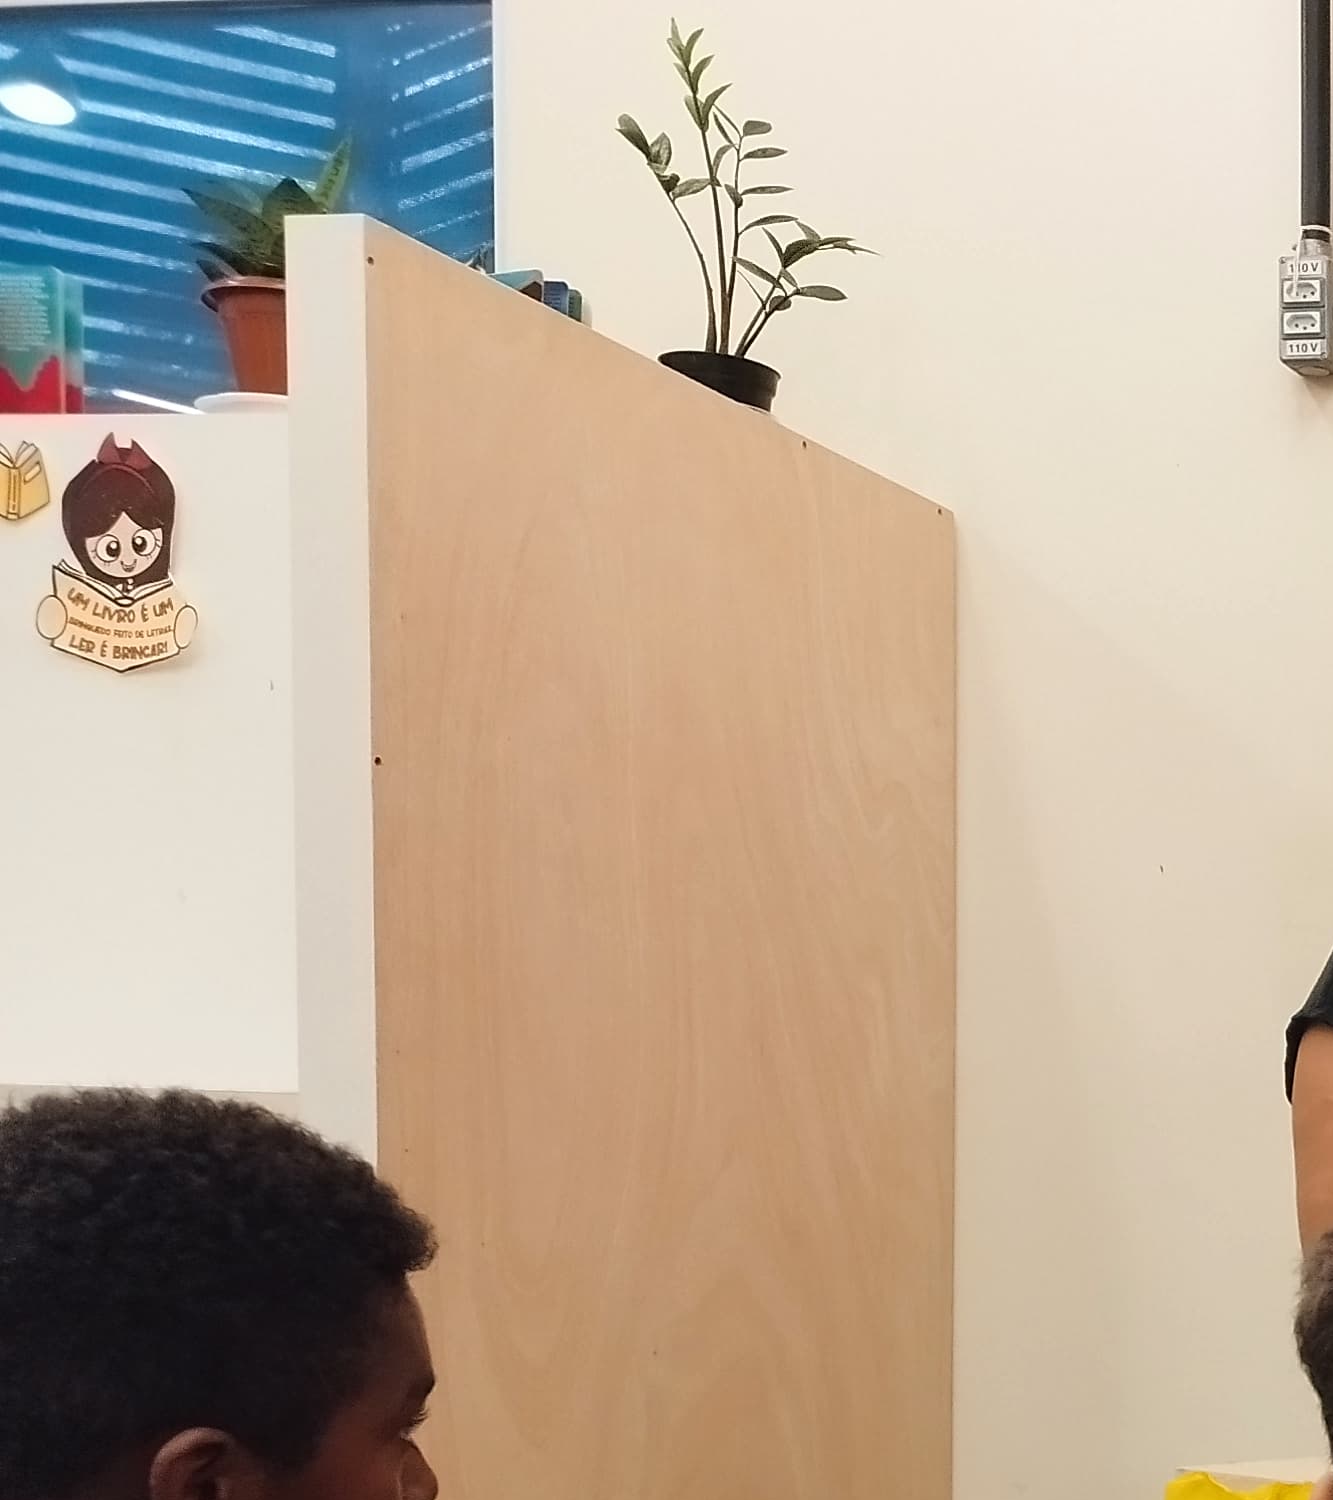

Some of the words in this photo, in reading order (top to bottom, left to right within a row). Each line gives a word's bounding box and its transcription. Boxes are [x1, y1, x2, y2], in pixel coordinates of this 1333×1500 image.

[1311, 262, 1319, 272] V
[1289, 344, 1308, 353] 110
[1310, 343, 1318, 352] V
[67, 587, 91, 611] UM
[92, 602, 136, 623] LIVRO
[141, 602, 149, 623] É
[153, 597, 174, 617] UM
[69, 634, 96, 653] LER
[100, 640, 109, 657] É
[112, 641, 168, 660] BRINCAR!
